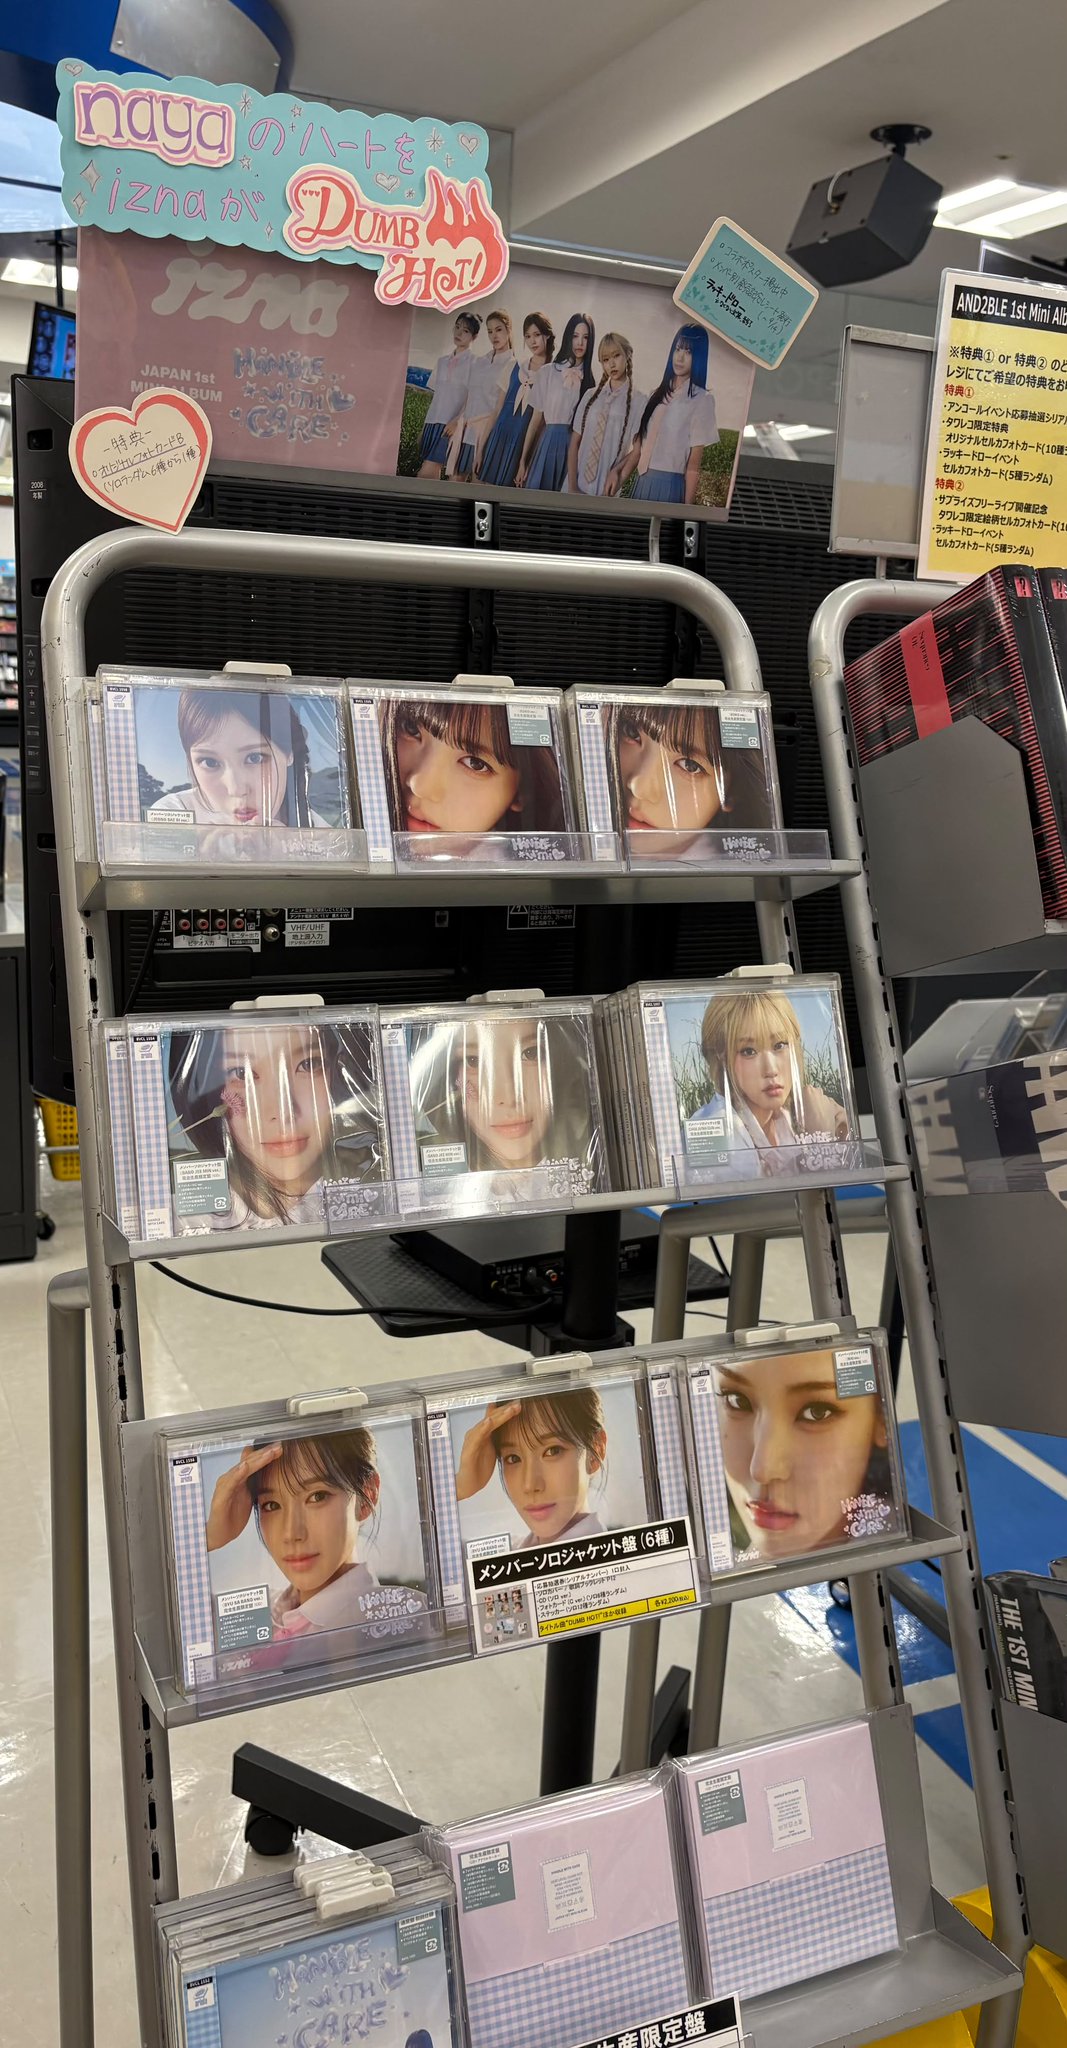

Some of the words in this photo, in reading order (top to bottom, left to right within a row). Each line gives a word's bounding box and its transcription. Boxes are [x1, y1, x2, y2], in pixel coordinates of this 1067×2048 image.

[81, 89, 229, 155] naya
[248, 117, 416, 176] のハートを
[108, 168, 208, 223] izna
[220, 188, 267, 224] が
[300, 175, 420, 249] DUMB
[705, 278, 746, 313] ラッキードロー
[956, 292, 1009, 317] AND2BLE
[1010, 299, 1026, 320] 1st
[1029, 303, 1050, 324] Mini
[140, 364, 192, 382] JAPAN
[194, 371, 216, 385] 1st
[998, 353, 1012, 364] or
[130, 380, 165, 393] MI
[171, 385, 223, 402] BUM
[944, 384, 974, 399] 特典①
[247, 404, 331, 443] CARE
[30, 481, 44, 489] 2008
[935, 478, 965, 492] 特典②
[290, 923, 325, 932] VHF/UHF
[478, 1535, 637, 1582] メンバーソロジャケット盤
[640, 1527, 675, 1550] (6種)
[1000, 1597, 1024, 1632] THE
[1006, 1636, 1031, 1669] 1ST
[1013, 1669, 1039, 1712] MIN
